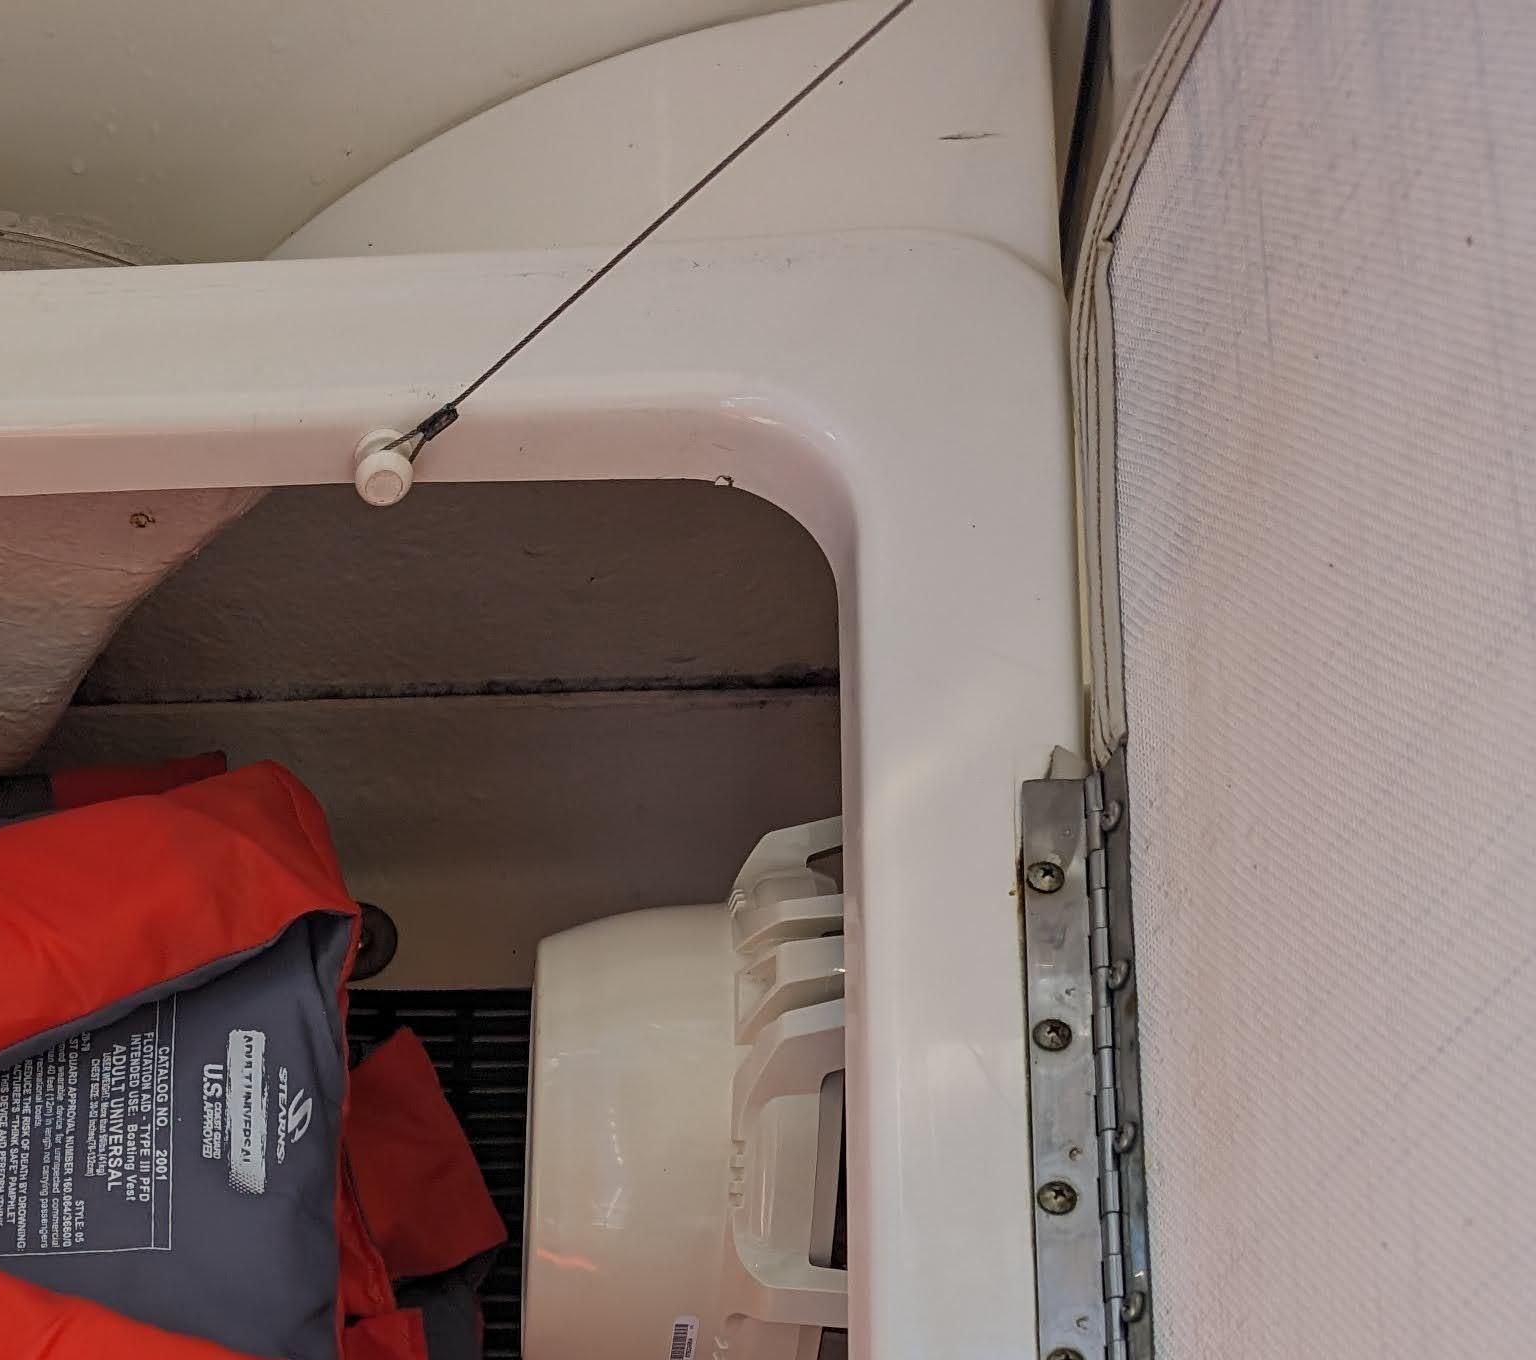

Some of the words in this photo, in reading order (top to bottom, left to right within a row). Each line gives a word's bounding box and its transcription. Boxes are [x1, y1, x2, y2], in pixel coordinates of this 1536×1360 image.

[22, 1060, 33, 1094] REDUCE
[68, 1053, 77, 1084] GUARD
[102, 1053, 110, 1071] USER
[111, 1044, 126, 1092] ADULT
[129, 1034, 141, 1088] INTENDED
[141, 1032, 154, 1090] FLOTATION
[157, 1046, 168, 1103] CATALOG
[203, 1064, 223, 1100] U.S.
[0, 1096, 8, 1128] DEVICE
[22, 1097, 31, 1114] THE
[44, 1094, 54, 1116] (12m)
[66, 1087, 76, 1134] APPROVAL
[128, 1091, 138, 1116] USE:
[141, 1093, 152, 1113] AID
[156, 1107, 168, 1130] NO.
[21, 1117, 31, 1137] RISK
[140, 1124, 150, 1156] TYPE
[202, 1101, 213, 1158] APPROVED
[64, 1136, 75, 1174] NUMBER
[108, 1100, 123, 1191] UNIVERSAL
[124, 1125, 137, 1170] Boating
[19, 1153, 29, 1180] DEATH
[40, 1165, 50, 1197] carrying
[140, 1161, 150, 1172] III
[156, 1150, 167, 1180] 2001
[6, 1177, 17, 1224] PAMPHLET
[126, 1175, 136, 1201] Vest
[139, 1177, 149, 1202] PFD
[17, 1196, 27, 1251] DROWNING:
[40, 1199, 49, 1248] passengers
[51, 1198, 60, 1248] commercial
[75, 1200, 84, 1229] STYLE:
